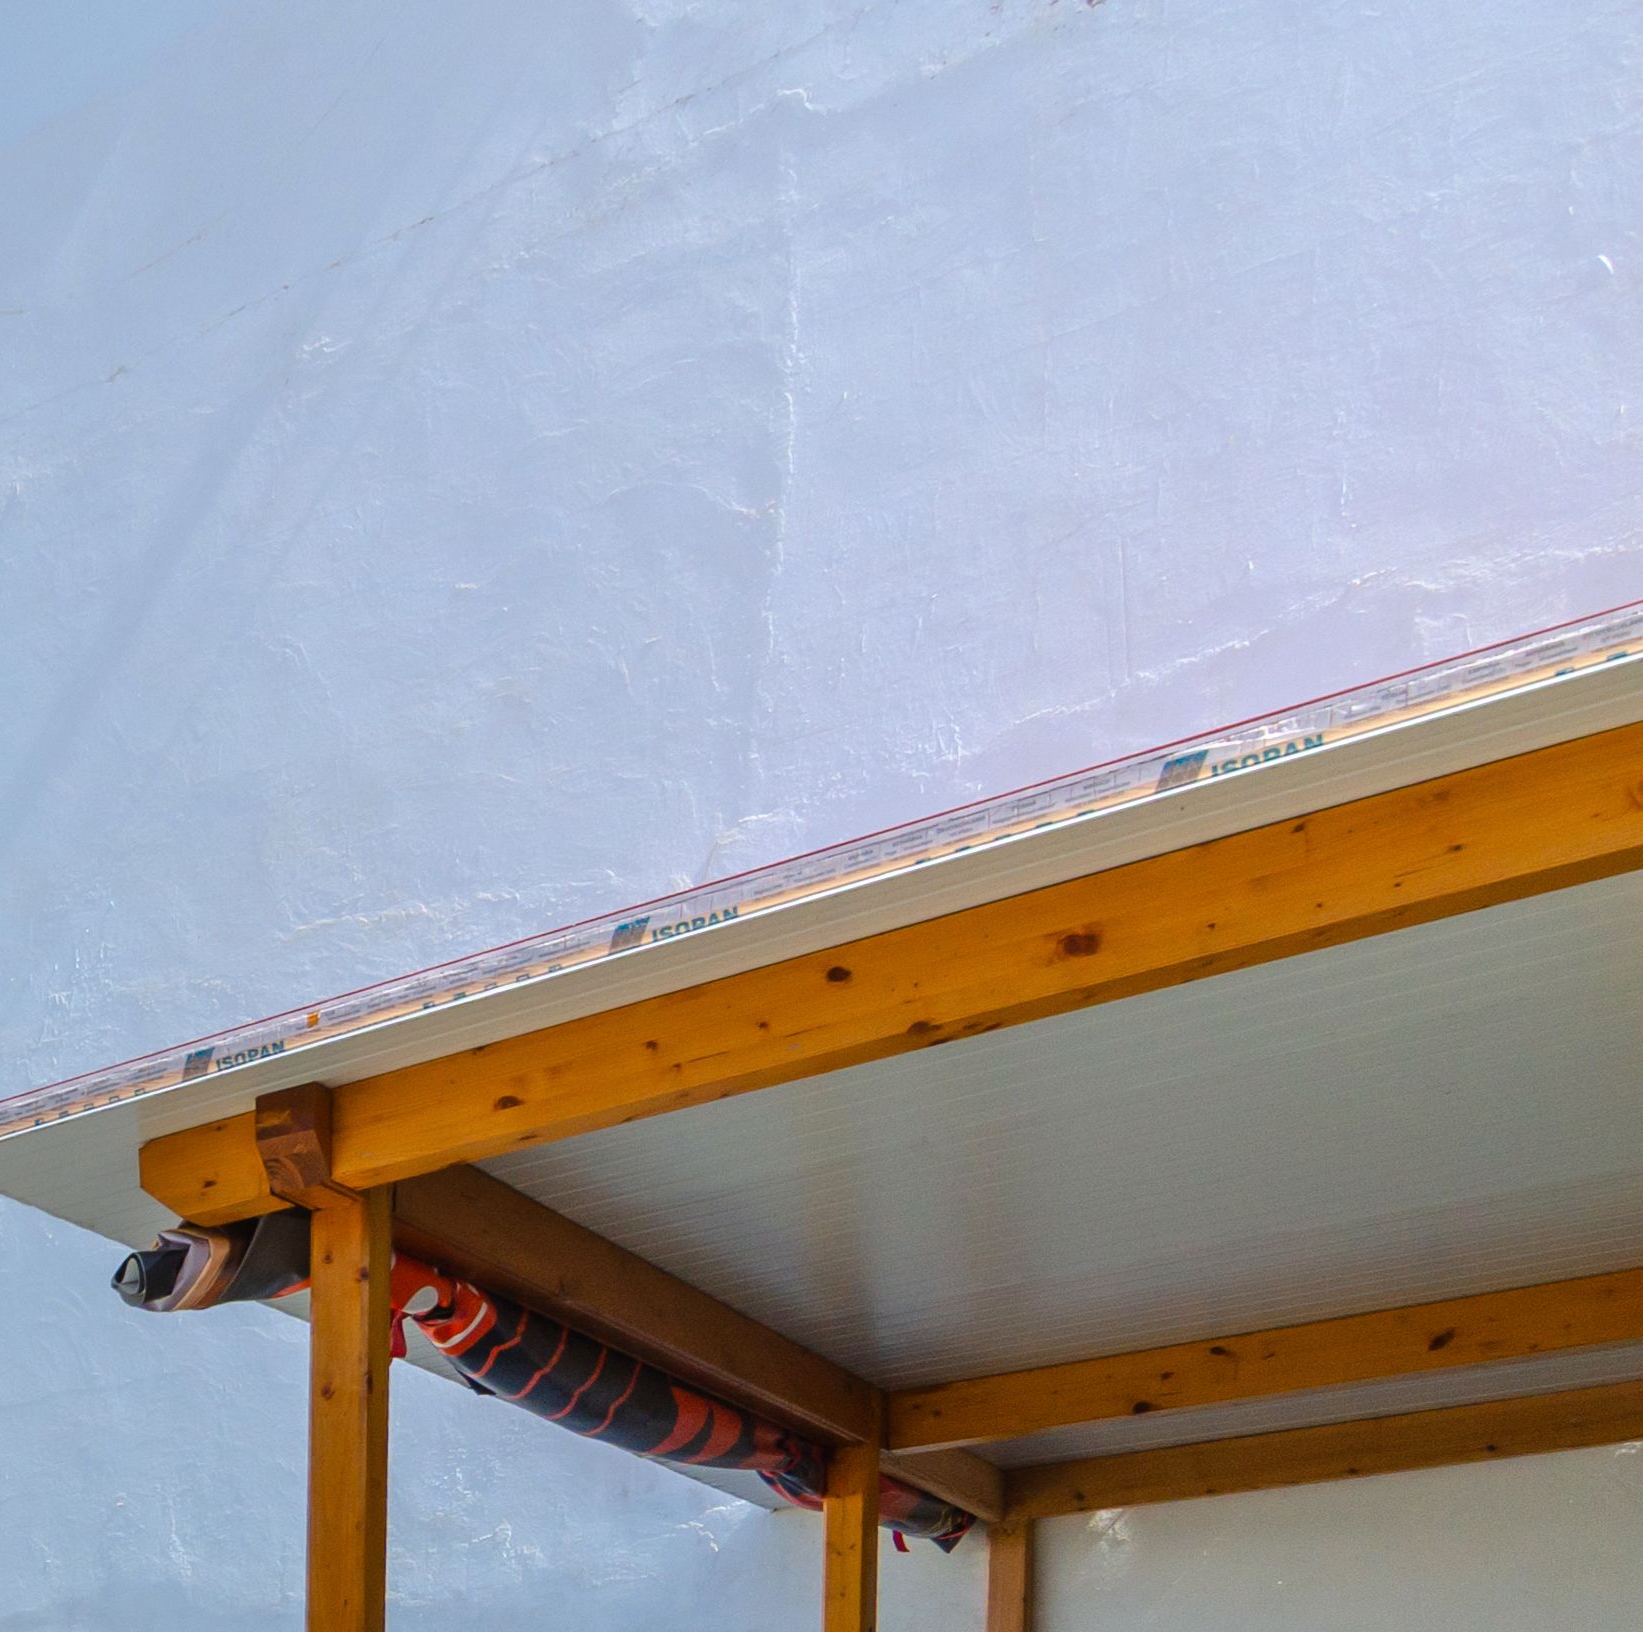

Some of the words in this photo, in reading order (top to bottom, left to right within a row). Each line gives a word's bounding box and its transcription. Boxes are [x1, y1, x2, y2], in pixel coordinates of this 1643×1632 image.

[1211, 734, 1323, 776] ISOPAN
[651, 906, 738, 943] ISOPAN
[216, 1040, 284, 1072] ISOPAN
